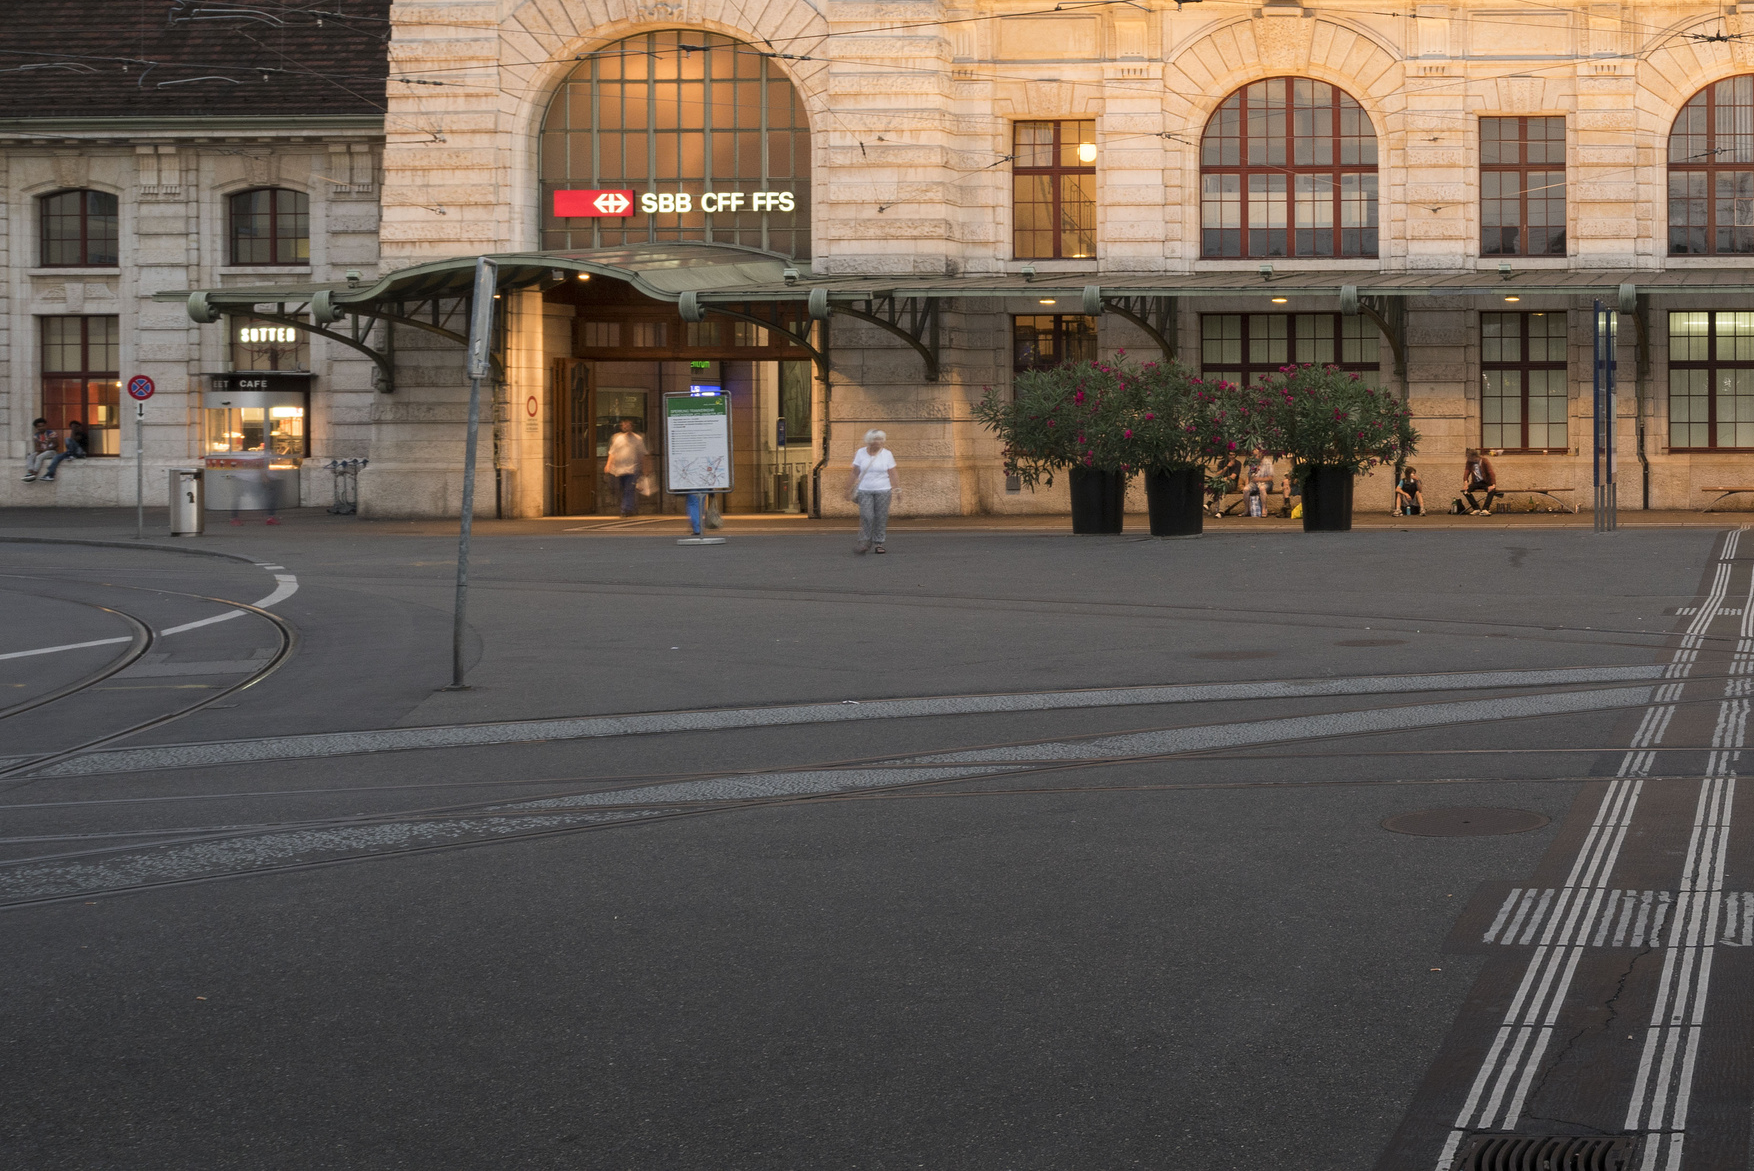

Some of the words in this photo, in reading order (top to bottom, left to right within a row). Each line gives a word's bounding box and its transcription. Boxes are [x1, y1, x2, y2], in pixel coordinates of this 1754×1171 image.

[641, 192, 692, 213] SBB
[701, 192, 745, 213] CFF
[752, 191, 796, 212] FFS
